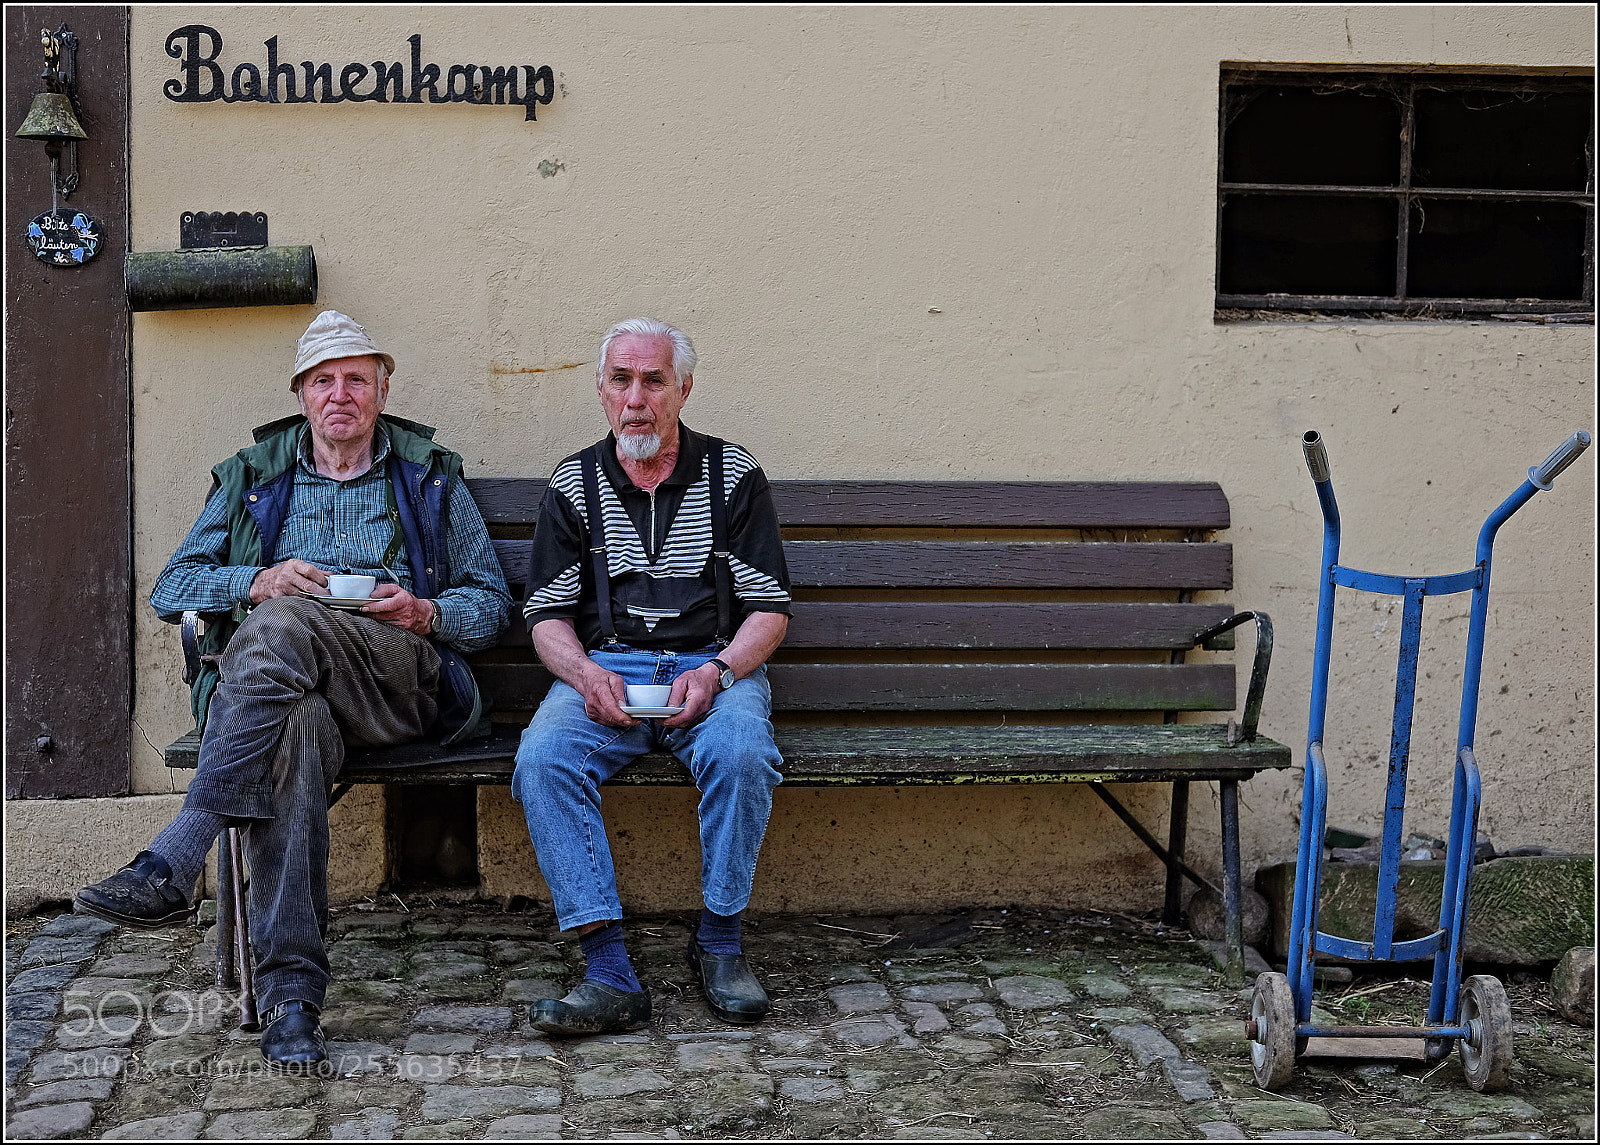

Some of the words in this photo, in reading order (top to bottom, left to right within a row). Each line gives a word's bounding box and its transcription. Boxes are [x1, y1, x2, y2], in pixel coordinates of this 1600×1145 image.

[163, 24, 555, 121] Bohnenkamp
[41, 216, 69, 231] Bite
[39, 235, 79, 250] läuten
